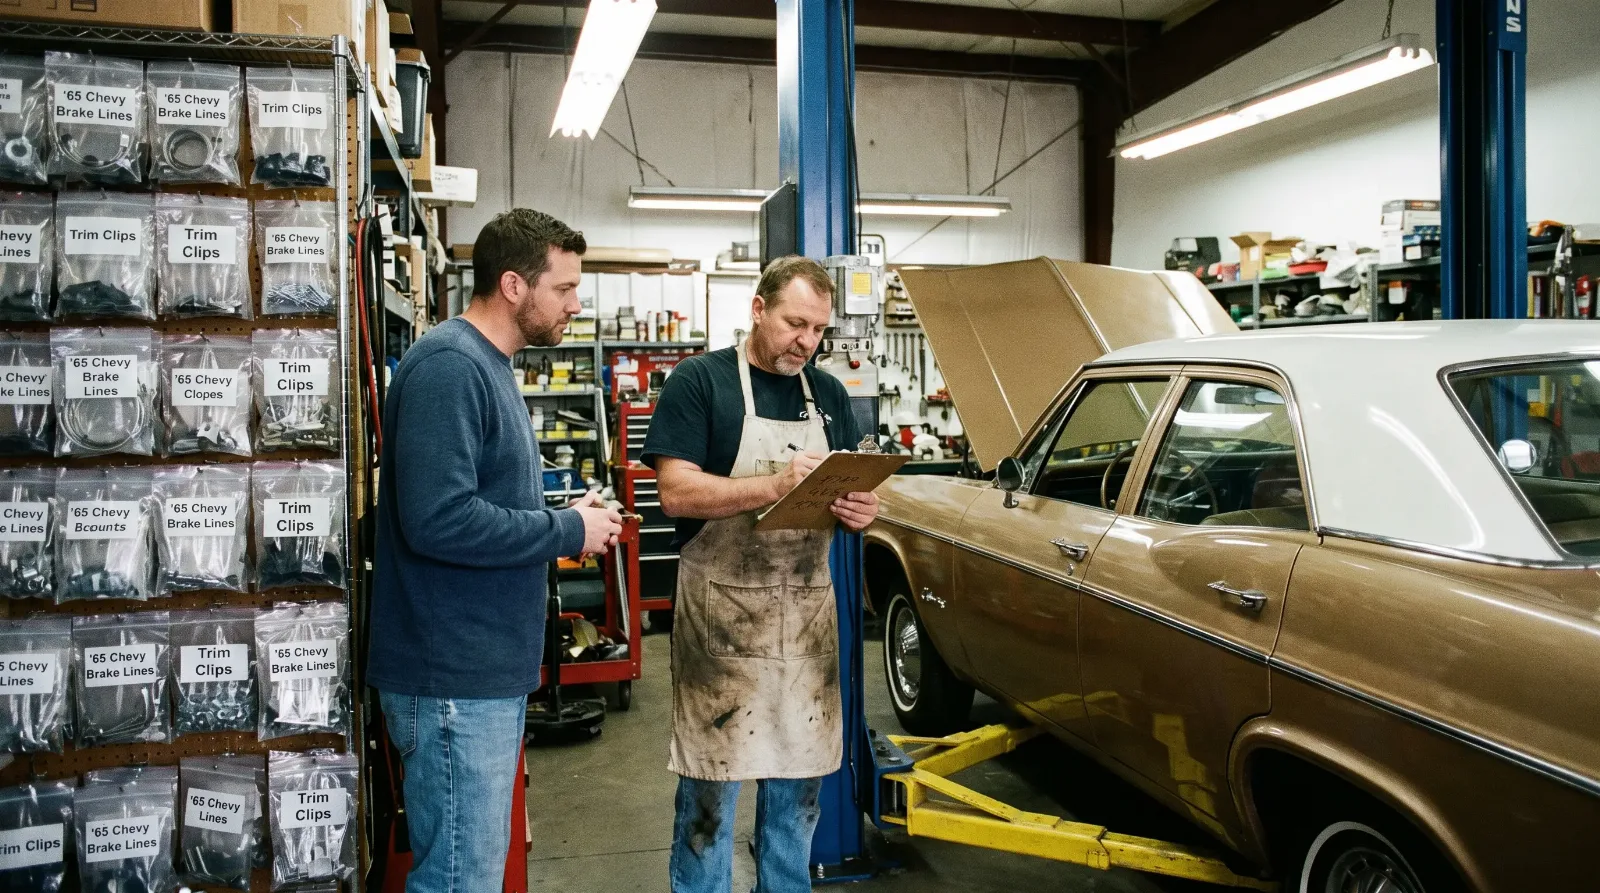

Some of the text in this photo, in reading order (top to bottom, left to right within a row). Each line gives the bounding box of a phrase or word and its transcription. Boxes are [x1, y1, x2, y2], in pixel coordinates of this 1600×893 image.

[64, 90, 126, 106] '65 Chevy
[165, 94, 220, 107] '65 Chevy
[56, 106, 133, 121] Brake Lines
[158, 108, 226, 120] Brake Lines
[262, 103, 322, 115] Trim Clips
[0, 230, 32, 244] hevy
[70, 230, 136, 242] Trim Clips
[184, 228, 217, 240] Trim
[272, 234, 320, 244] '65 Chevy
[182, 246, 220, 260] Clips
[267, 246, 325, 255] Brake Lines
[70, 358, 131, 369] '65 Chevy
[279, 362, 311, 373] Trim
[6, 373, 46, 384] Chevy
[83, 372, 120, 381] Brake
[175, 375, 232, 386] '65 Chevy
[277, 379, 314, 391] Clips
[18, 387, 50, 397] Lines
[84, 387, 118, 396] Lines
[184, 390, 223, 400] Clopes
[70, 507, 130, 519] '65 Chevy
[171, 504, 228, 514] '65 Chevy
[279, 502, 311, 514] Trim
[4, 508, 44, 521] Chevy
[11, 524, 44, 533] Lines
[168, 519, 235, 528] Brake Lines
[276, 520, 314, 532] Clips
[90, 653, 146, 663] '65 Chevy
[198, 647, 230, 658] Trim
[275, 647, 328, 658] '65 Chevy
[9, 661, 48, 672] Chevy
[86, 666, 154, 679] Brake Lines
[195, 664, 232, 677] Clips
[272, 662, 336, 674] Brake Lines
[0, 677, 34, 686] Lines
[298, 792, 329, 804] Trim
[190, 796, 240, 814] '65 Chevy
[199, 812, 228, 825] Lines
[295, 809, 331, 822] Clips
[92, 824, 149, 837] '65 Chevy
[0, 839, 61, 855] rim Clips
[87, 839, 157, 854] Brake Lines
